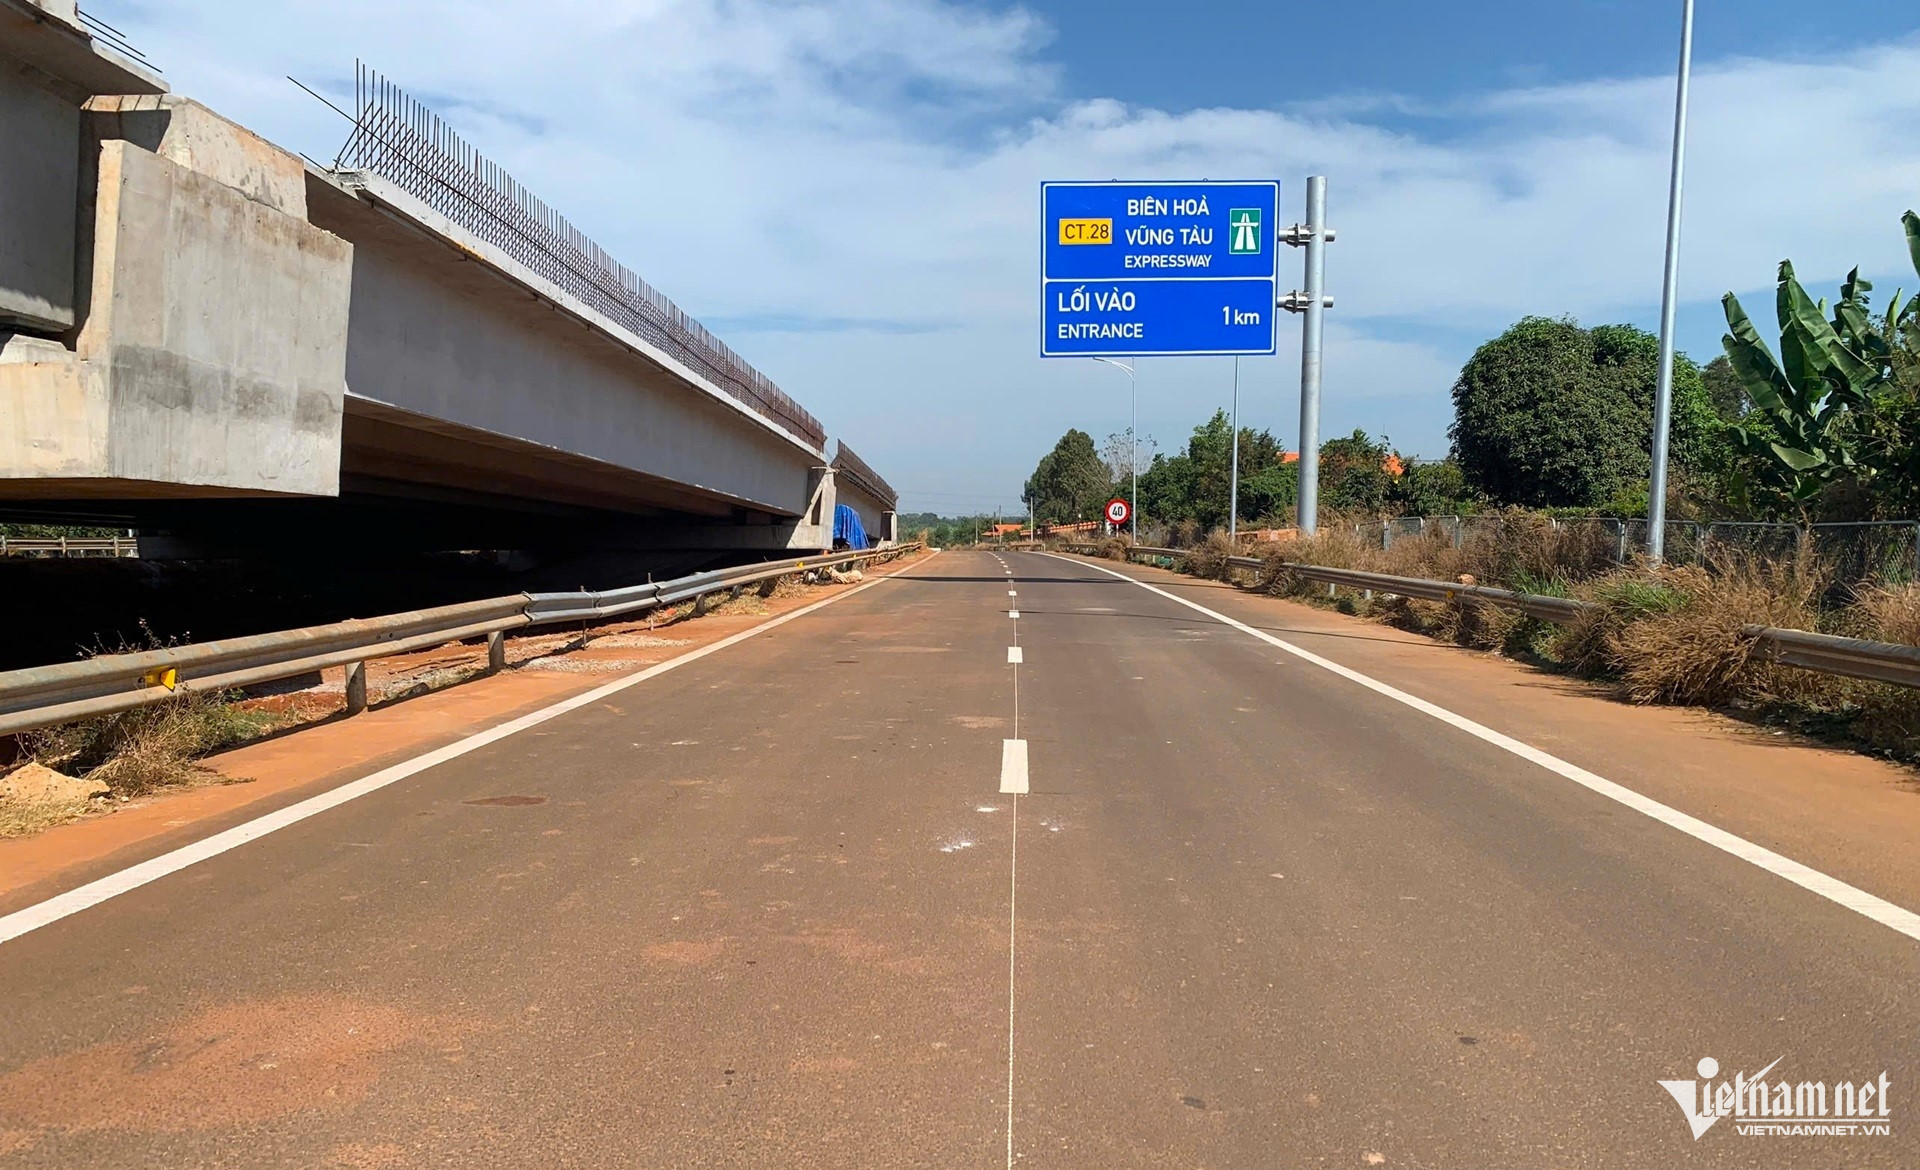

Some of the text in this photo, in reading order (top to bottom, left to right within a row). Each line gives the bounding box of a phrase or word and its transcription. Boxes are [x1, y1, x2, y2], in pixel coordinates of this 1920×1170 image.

[1127, 195, 1210, 216] BIÊN HOÀ
[1064, 223, 1110, 240] CT.28
[1125, 225, 1213, 246] VŨNG TÀU
[1124, 254, 1212, 269] EXPRESSWAY
[1058, 285, 1136, 312] LỐI VÀO
[1222, 306, 1260, 325] 1 km
[1058, 323, 1144, 339] ENTRANCE
[1112, 506, 1123, 516] 40
